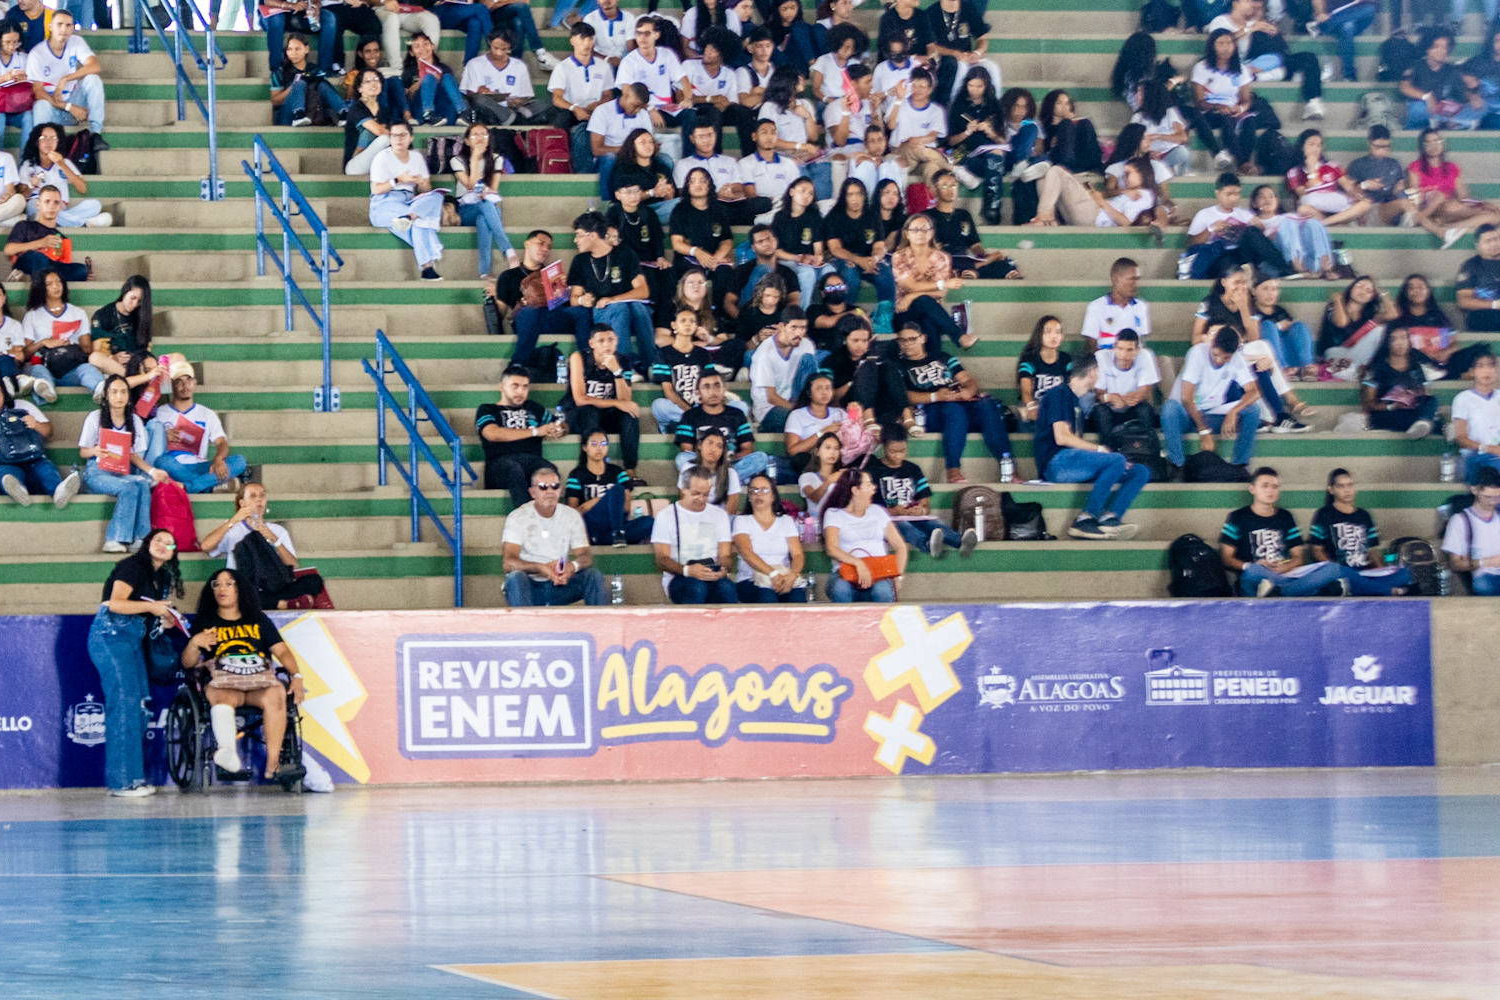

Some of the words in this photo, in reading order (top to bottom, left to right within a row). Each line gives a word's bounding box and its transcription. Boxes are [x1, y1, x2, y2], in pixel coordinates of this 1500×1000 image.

[673, 364, 699, 379] TER
[675, 378, 698, 391] CEI
[882, 476, 914, 492] TER
[418, 652, 575, 690] REVISÃO
[597, 647, 848, 740] Alagoas
[1018, 676, 1125, 701] ALAGOAS
[1213, 677, 1299, 697] PENEDO
[1319, 686, 1418, 705] JAGUAR
[419, 694, 576, 738] ENEM
[1082, 703, 1111, 711] POVO
